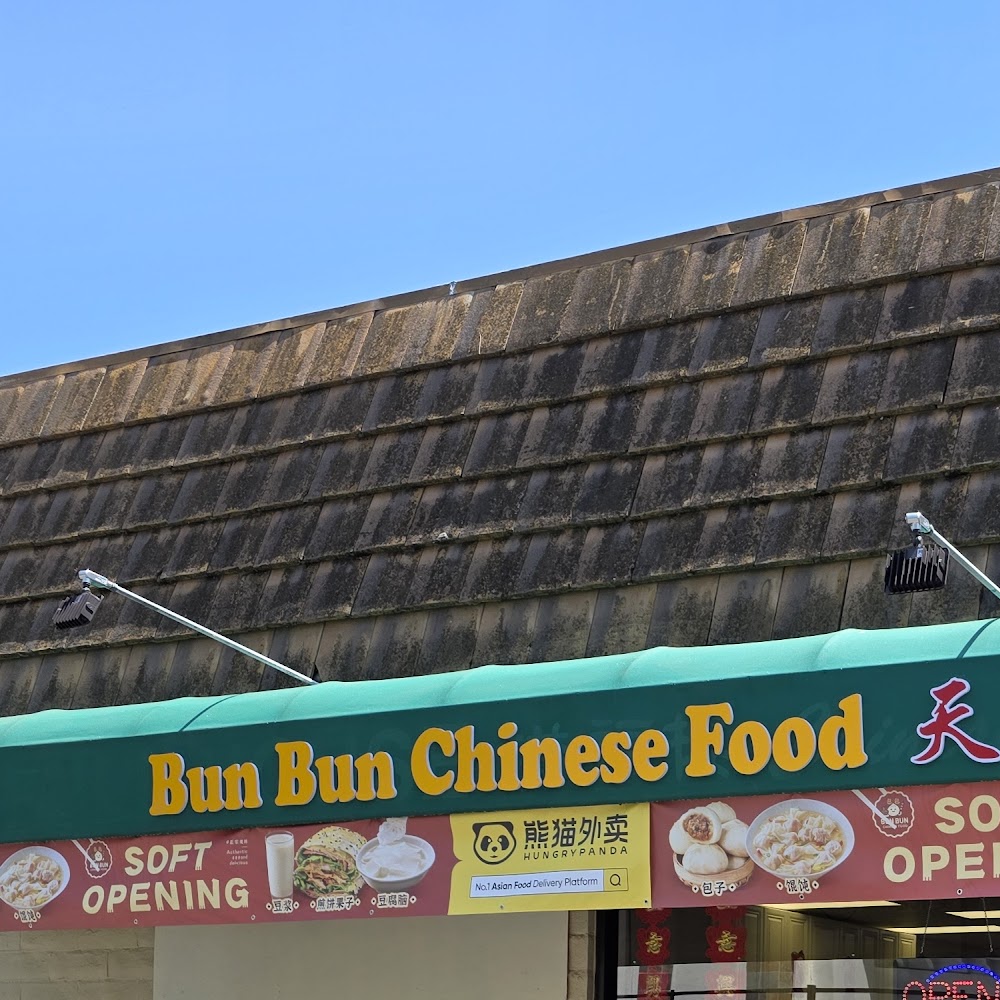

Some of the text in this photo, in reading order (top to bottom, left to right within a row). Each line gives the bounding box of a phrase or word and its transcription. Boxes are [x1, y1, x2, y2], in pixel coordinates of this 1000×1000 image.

[149, 694, 869, 815] Bun Bun Chinese Food
[523, 814, 629, 850] 熊猫外卖
[124, 841, 213, 876] SOFT
[523, 846, 628, 860] HUNGRYPANDA
[475, 877, 598, 891] No.1 Asian Food Delivery Platform
[702, 881, 726, 895] 包子
[786, 879, 810, 892] 馄饨
[82, 877, 250, 914] OPENING
[272, 901, 293, 912] 豆浆
